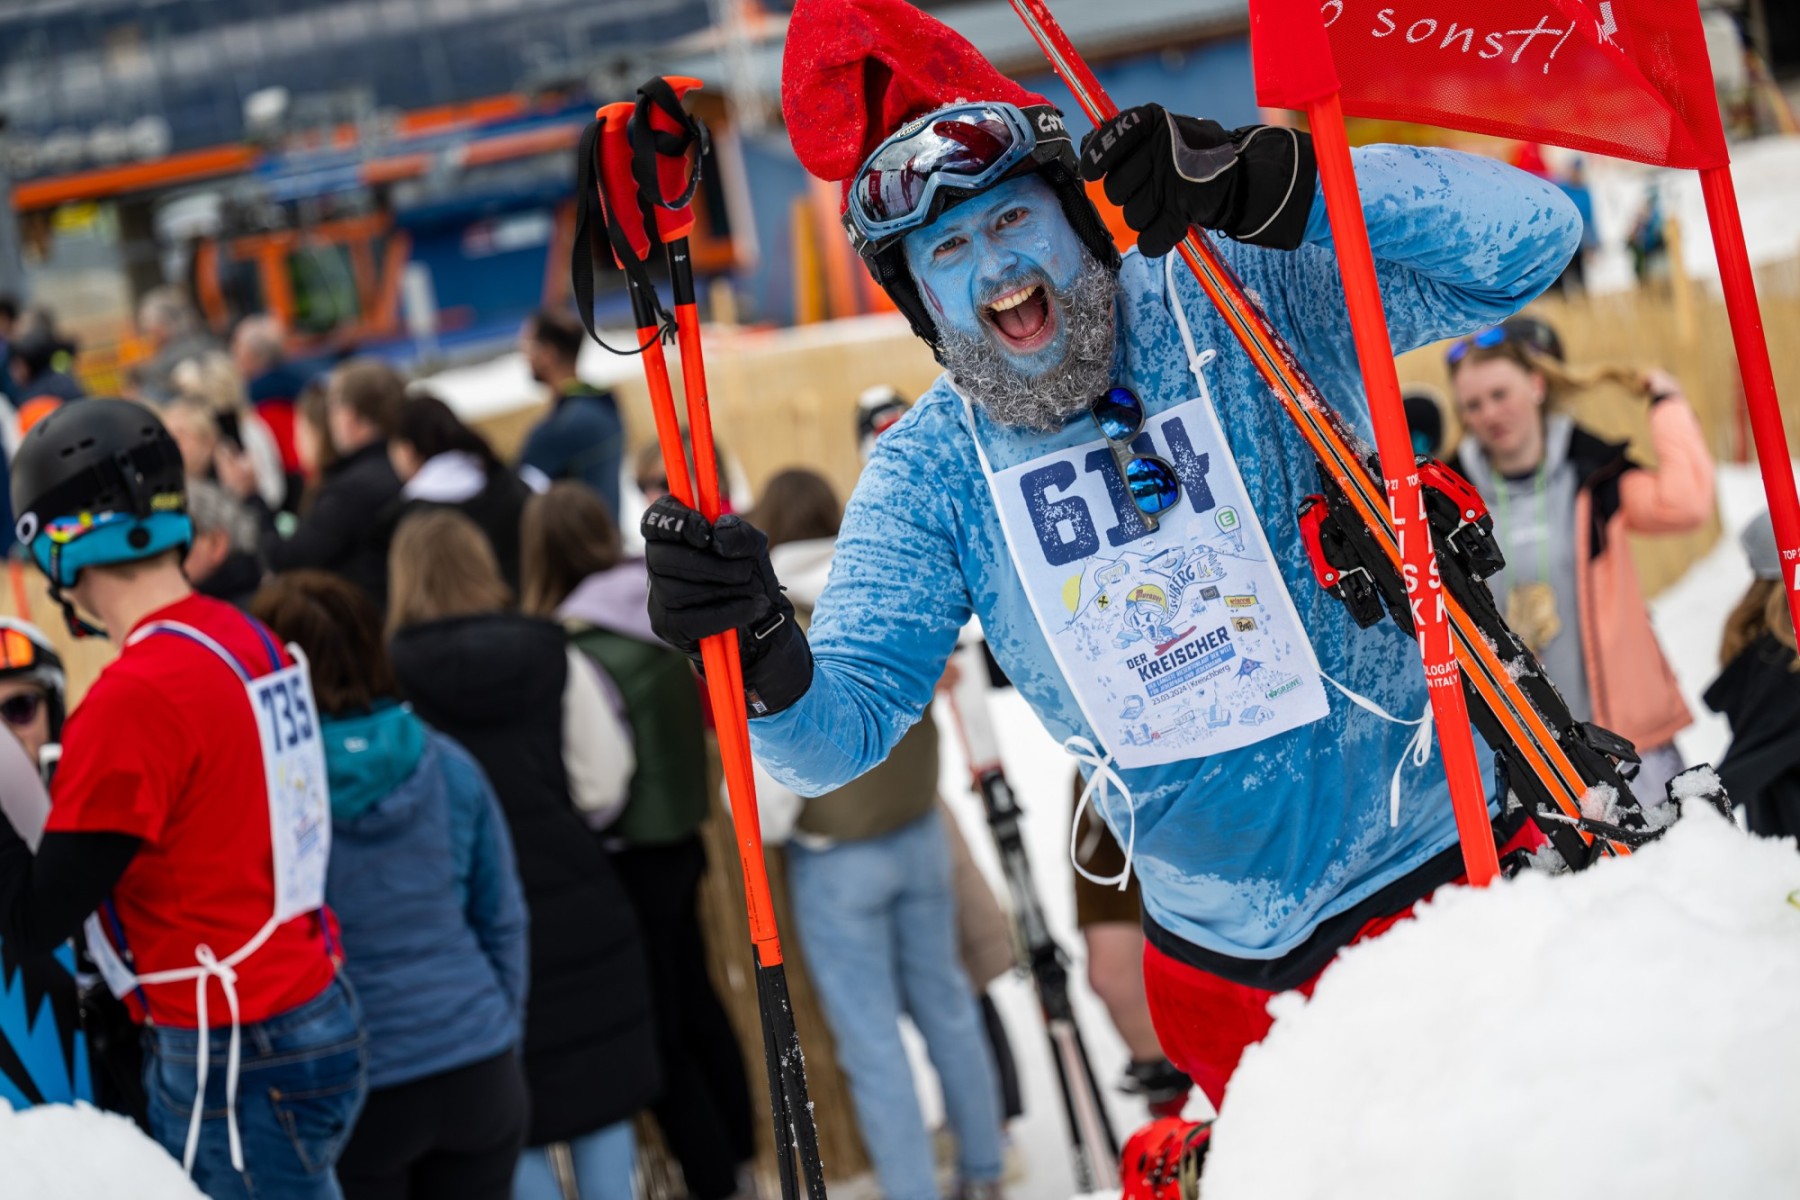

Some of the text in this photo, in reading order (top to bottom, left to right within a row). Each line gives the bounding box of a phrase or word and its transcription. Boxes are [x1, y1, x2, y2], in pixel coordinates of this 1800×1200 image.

[1371, 8, 1576, 75] sonst!
[1089, 111, 1141, 165] LEKI
[1019, 416, 1216, 566] 614
[641, 510, 684, 533] EKI
[1782, 549, 1797, 560] TOP
[1126, 653, 1149, 670] DER
[1137, 626, 1231, 682] KREISCHER
[1151, 684, 1187, 706] 23.03.2024
[1189, 663, 1230, 687] Kreischberg
[1434, 674, 1458, 687] ITALY
[259, 675, 314, 753] 735
